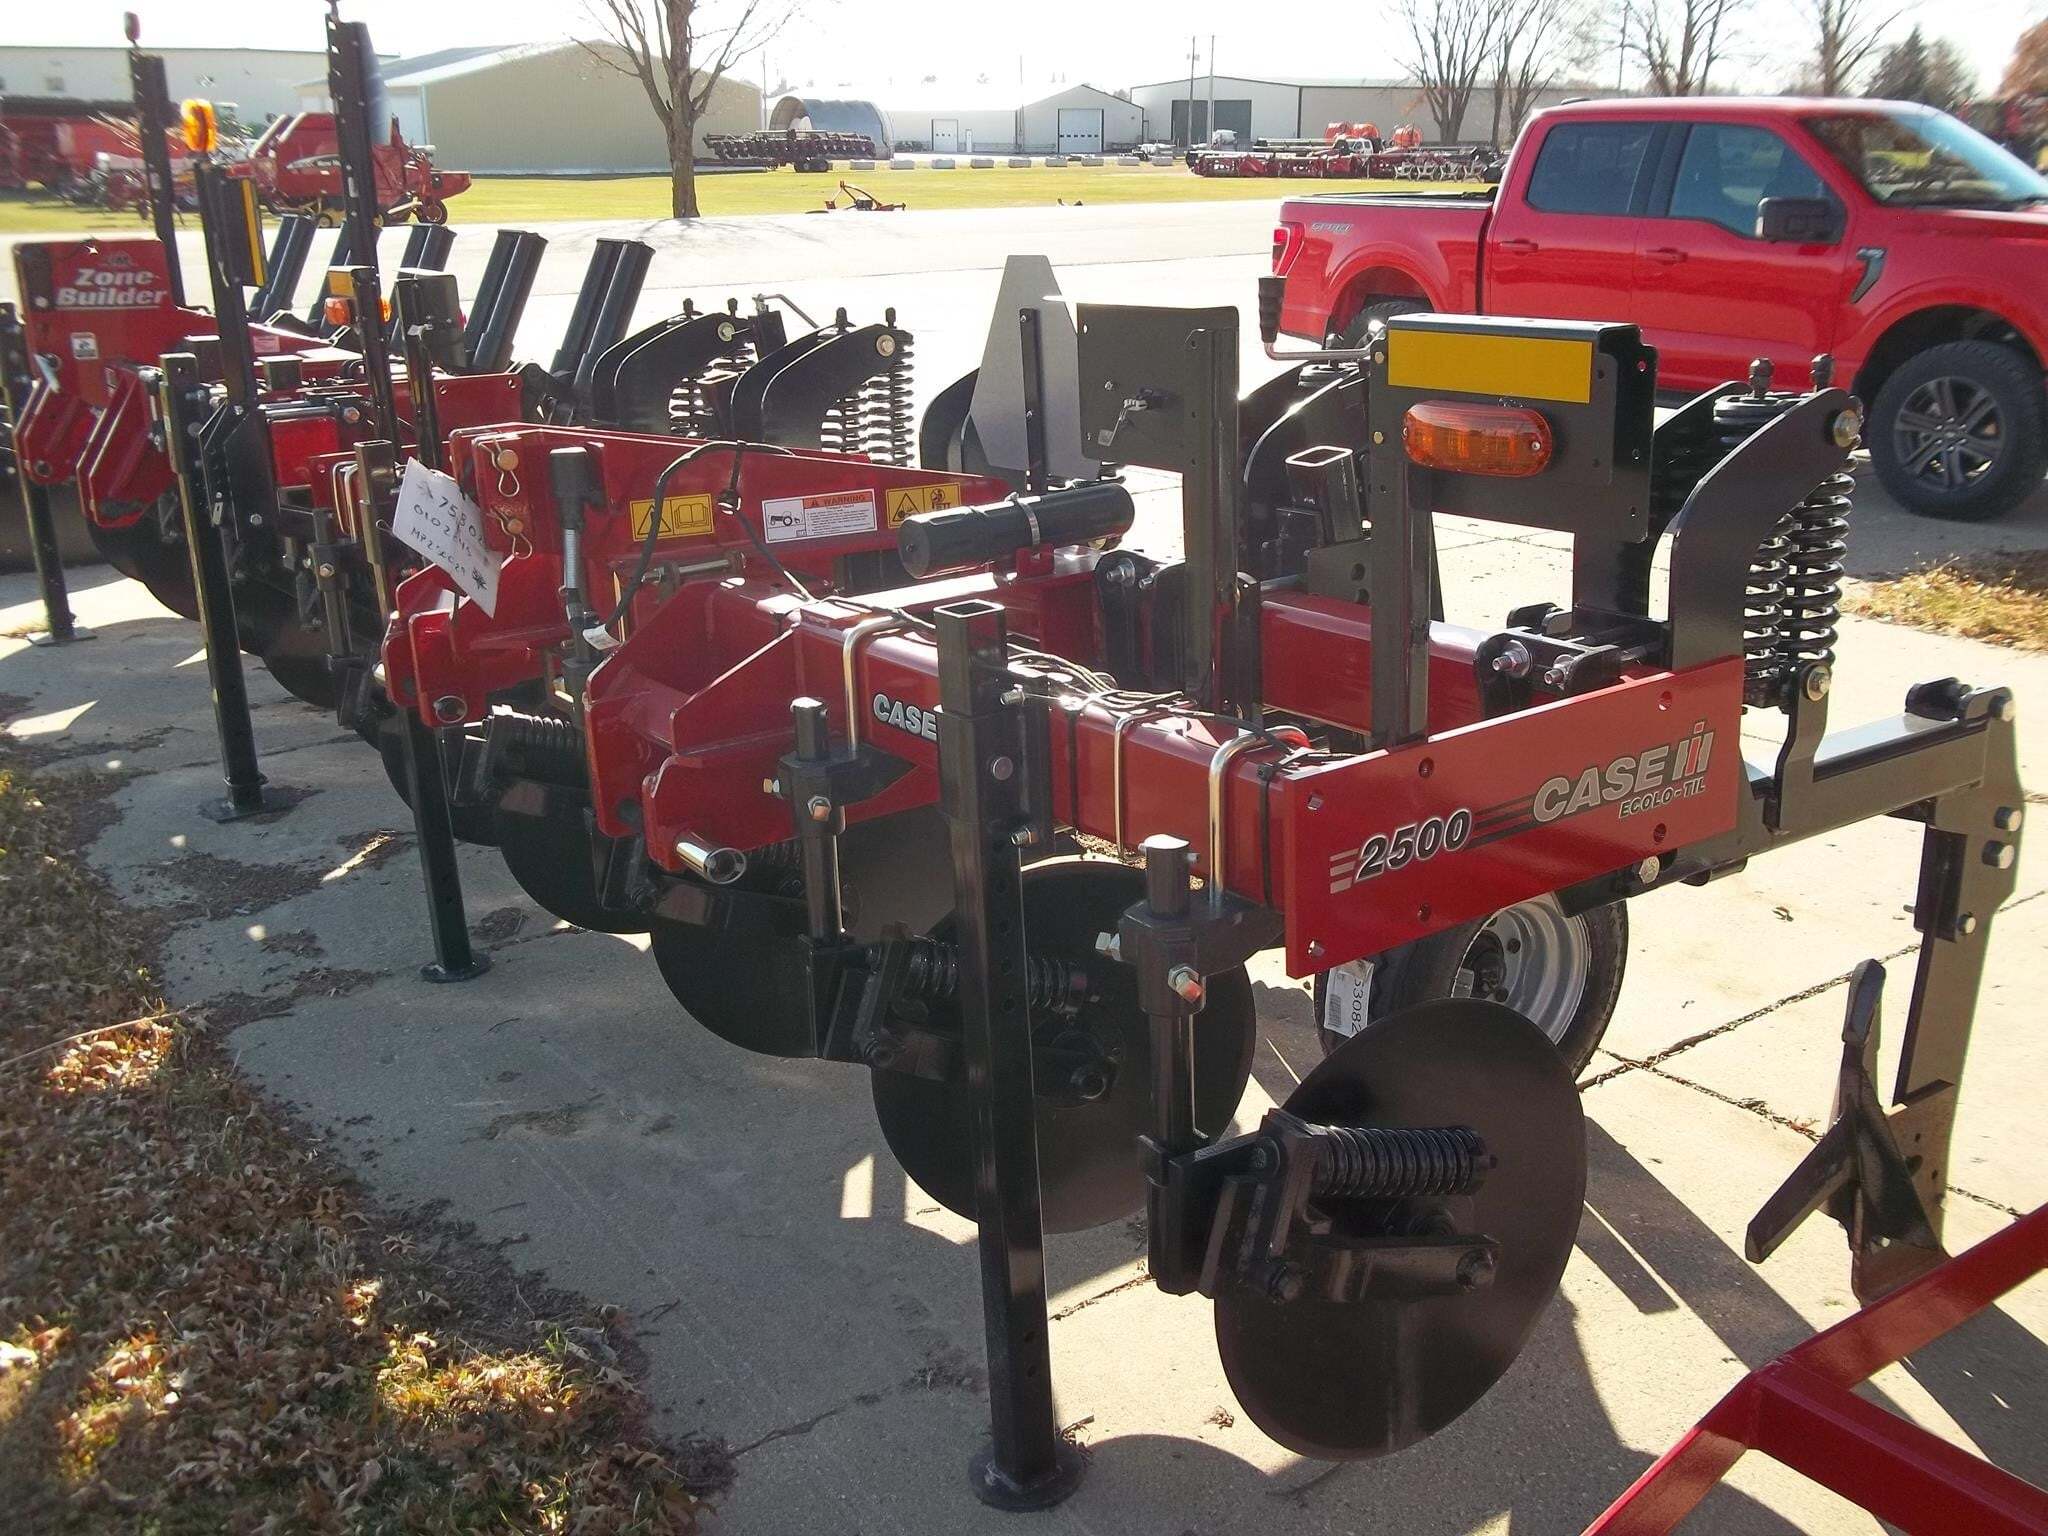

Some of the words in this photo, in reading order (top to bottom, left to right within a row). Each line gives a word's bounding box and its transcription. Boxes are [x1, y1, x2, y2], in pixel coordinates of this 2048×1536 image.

[74, 267, 155, 286] Zone
[56, 286, 168, 306] Builder
[824, 494, 866, 507] WARNING
[873, 693, 938, 741] CASE
[1532, 745, 1670, 824] CASE
[1354, 808, 1473, 883] 2500
